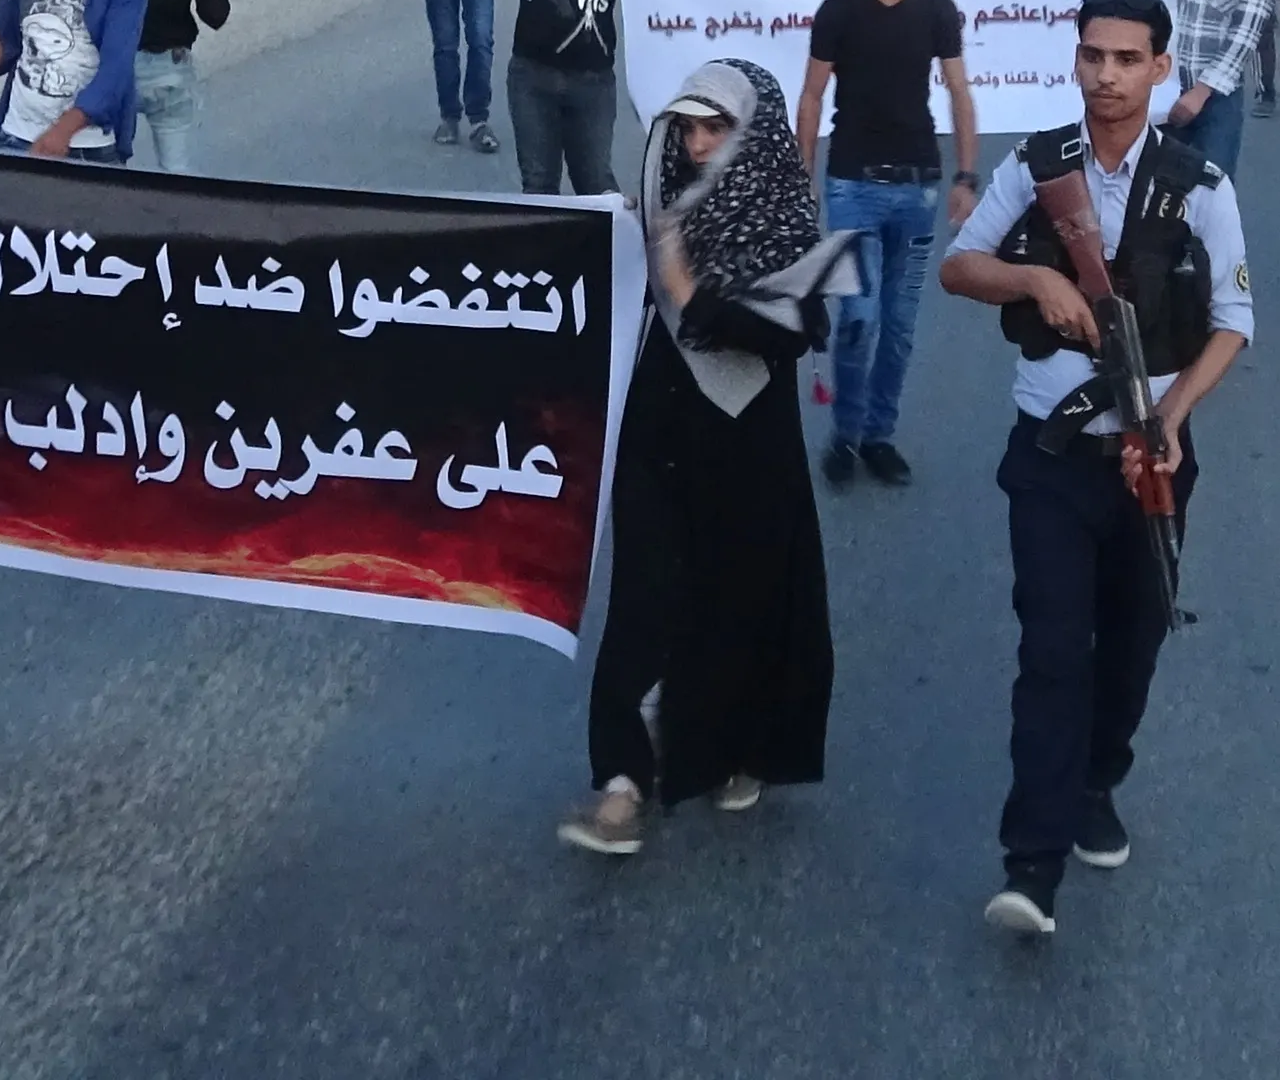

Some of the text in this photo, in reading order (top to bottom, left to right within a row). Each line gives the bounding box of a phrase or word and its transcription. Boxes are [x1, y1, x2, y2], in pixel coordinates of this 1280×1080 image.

[648, 11, 697, 37] علينا
[705, 11, 763, 38] يتفرج
[771, 11, 815, 39] عالم
[974, 3, 1079, 32] صراعاتكم
[1043, 72, 1066, 88] من
[194, 253, 305, 313] ضد
[329, 258, 586, 338] انتفضوا
[5, 383, 186, 485] وإدلب
[204, 400, 418, 500] عفرين
[436, 420, 564, 509] على
